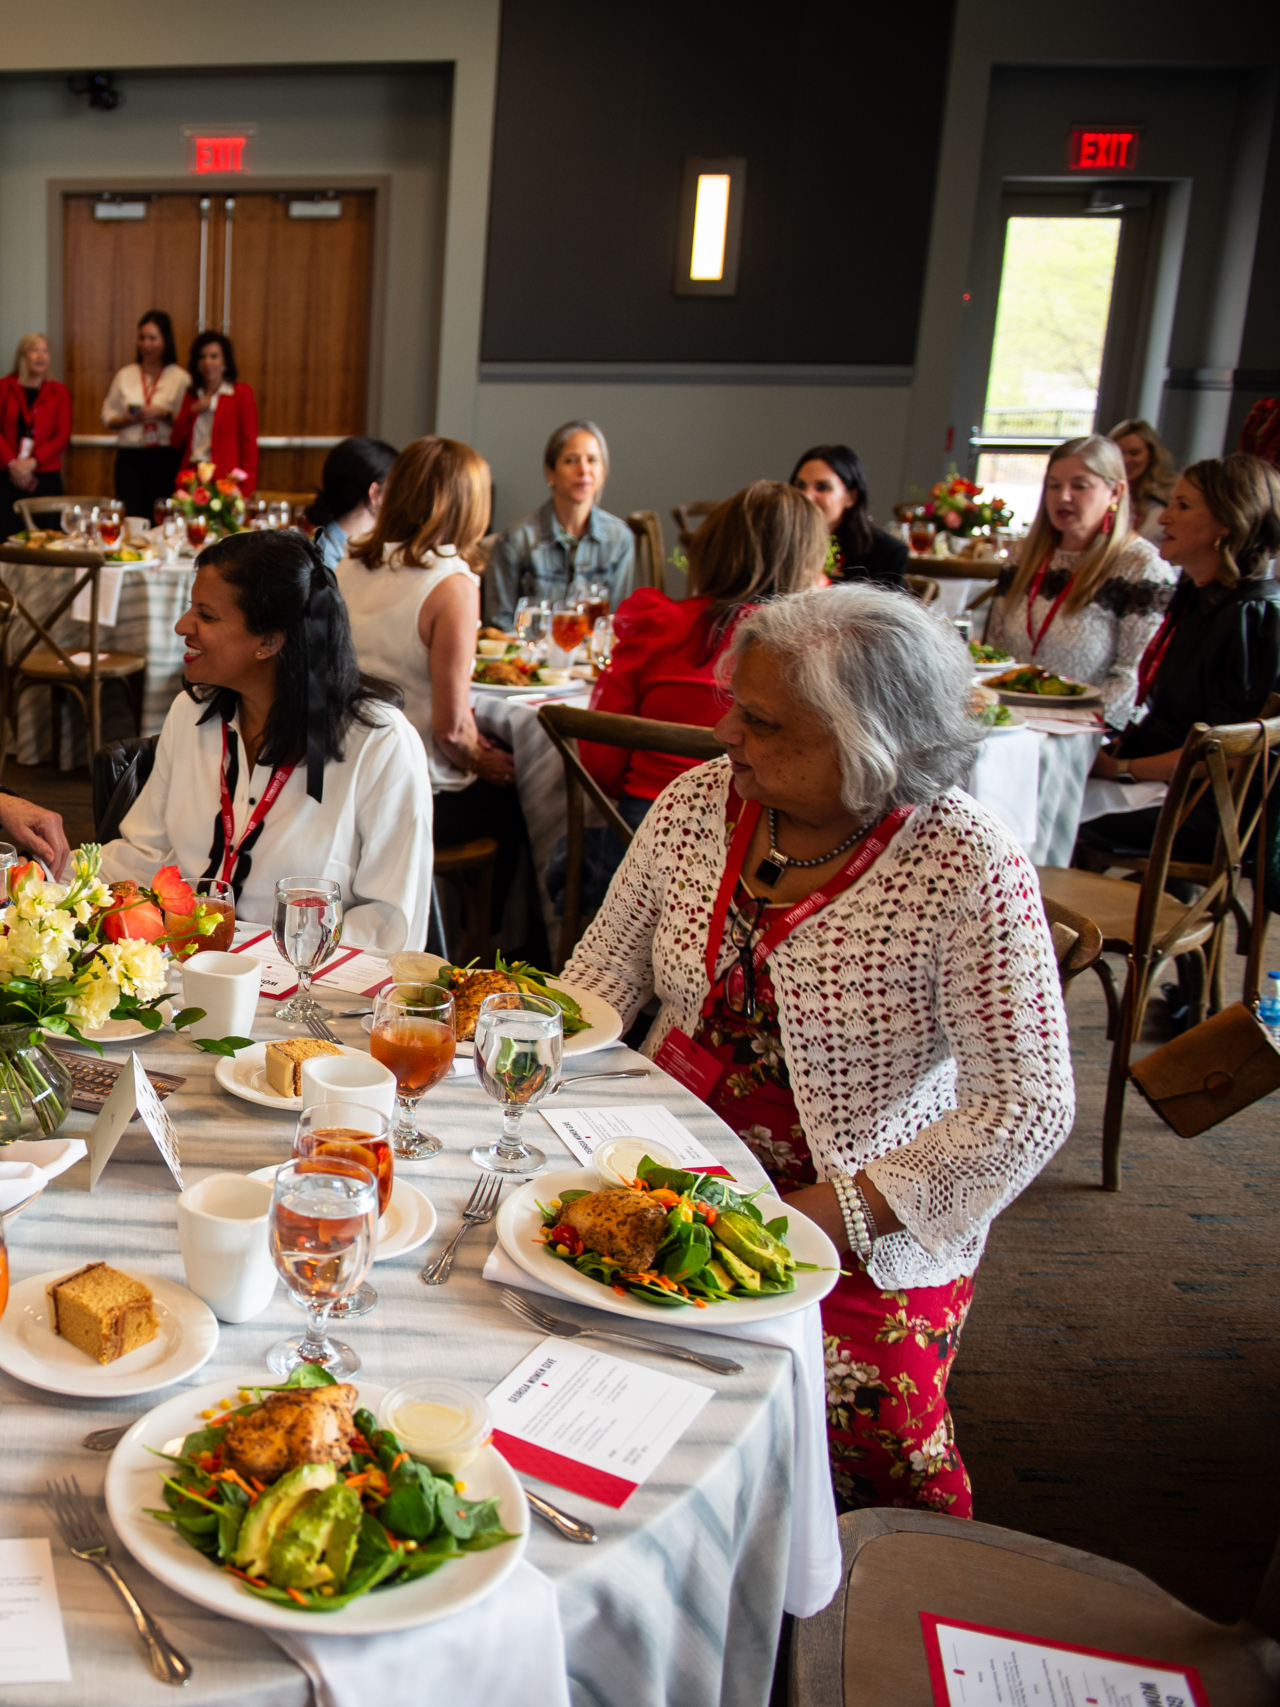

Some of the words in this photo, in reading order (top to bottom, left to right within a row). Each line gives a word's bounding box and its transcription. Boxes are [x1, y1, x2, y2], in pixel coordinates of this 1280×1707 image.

[196, 138, 246, 174] EXIT
[1079, 133, 1132, 168] EXIT
[508, 1383, 532, 1404] GEORGIA
[527, 1366, 546, 1386] WOMEN
[541, 1358, 557, 1371] GIVE
